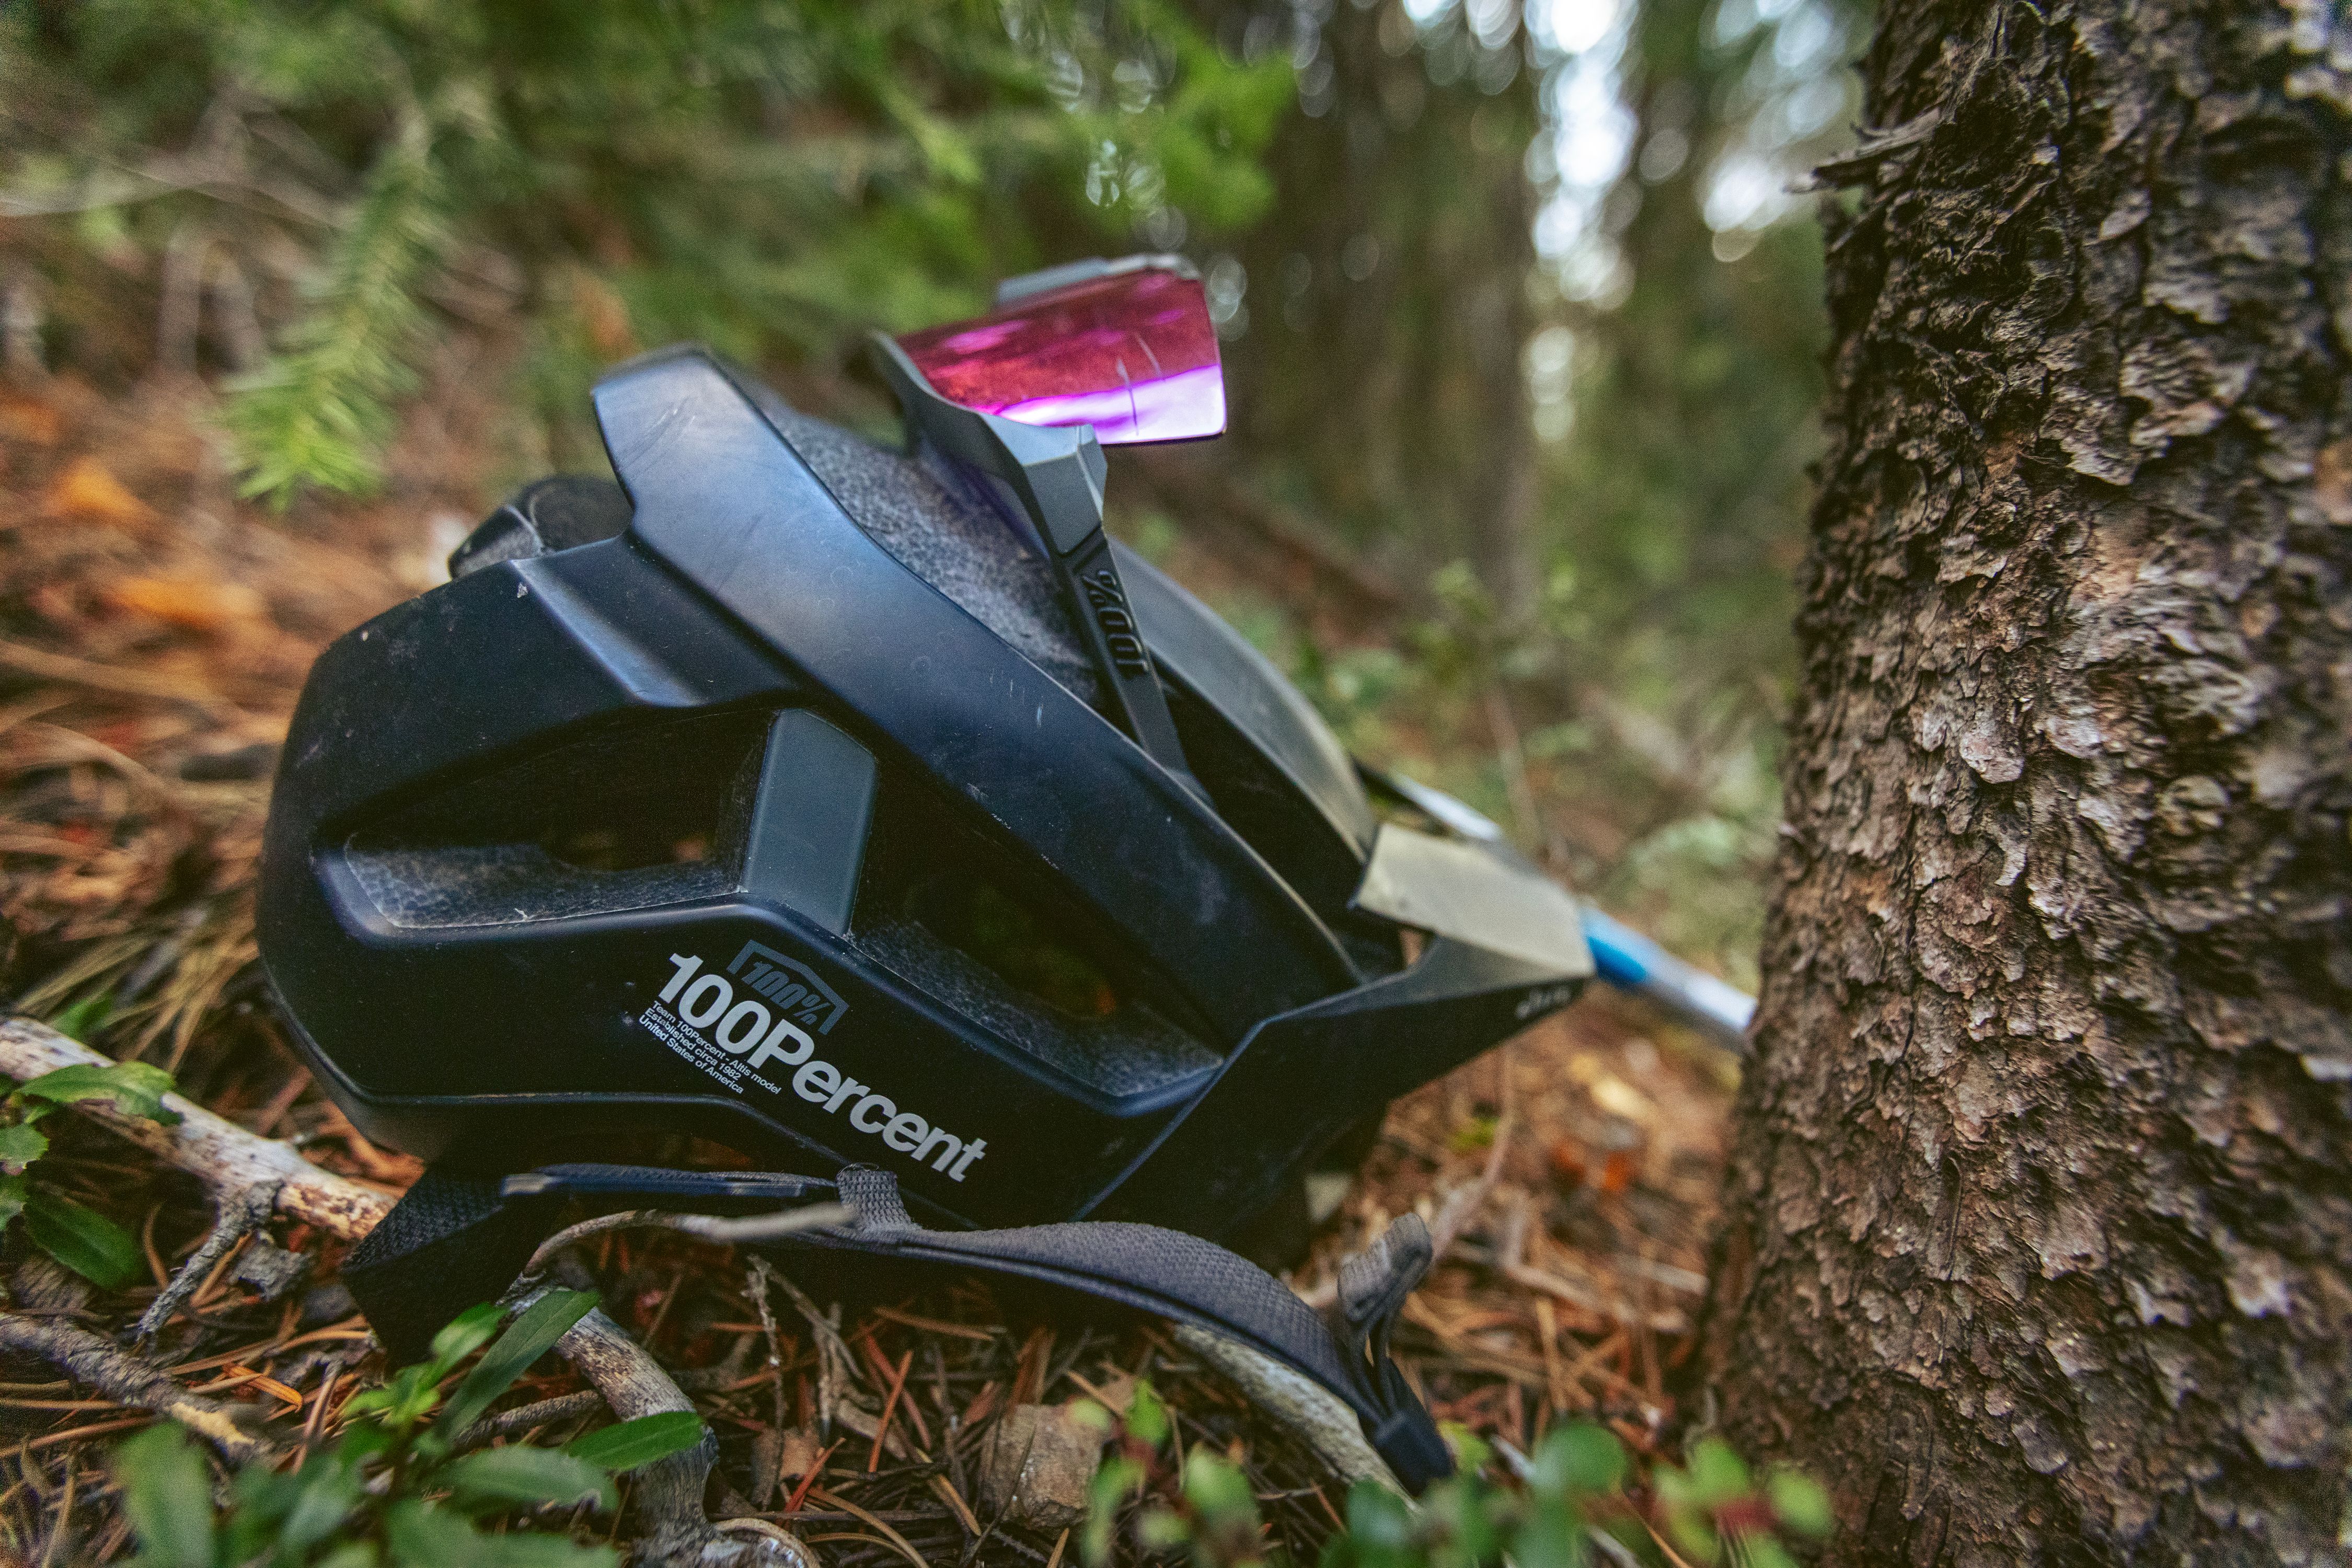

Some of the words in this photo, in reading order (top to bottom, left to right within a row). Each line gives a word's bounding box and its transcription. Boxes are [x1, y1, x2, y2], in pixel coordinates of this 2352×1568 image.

[741, 962, 831, 1025] 100%
[639, 1014, 669, 1042] United
[667, 1037, 696, 1062] States
[695, 1060, 708, 1069] of
[705, 1066, 744, 1094] America
[645, 1007, 697, 1051] Established
[695, 1048, 718, 1066] circa
[719, 1063, 742, 1081] 1982
[653, 1000, 676, 1023] Team
[677, 1021, 726, 1059] 100Percent
[729, 1059, 752, 1076] Altis
[751, 1073, 782, 1094] model
[658, 953, 988, 1182] 100Percent
